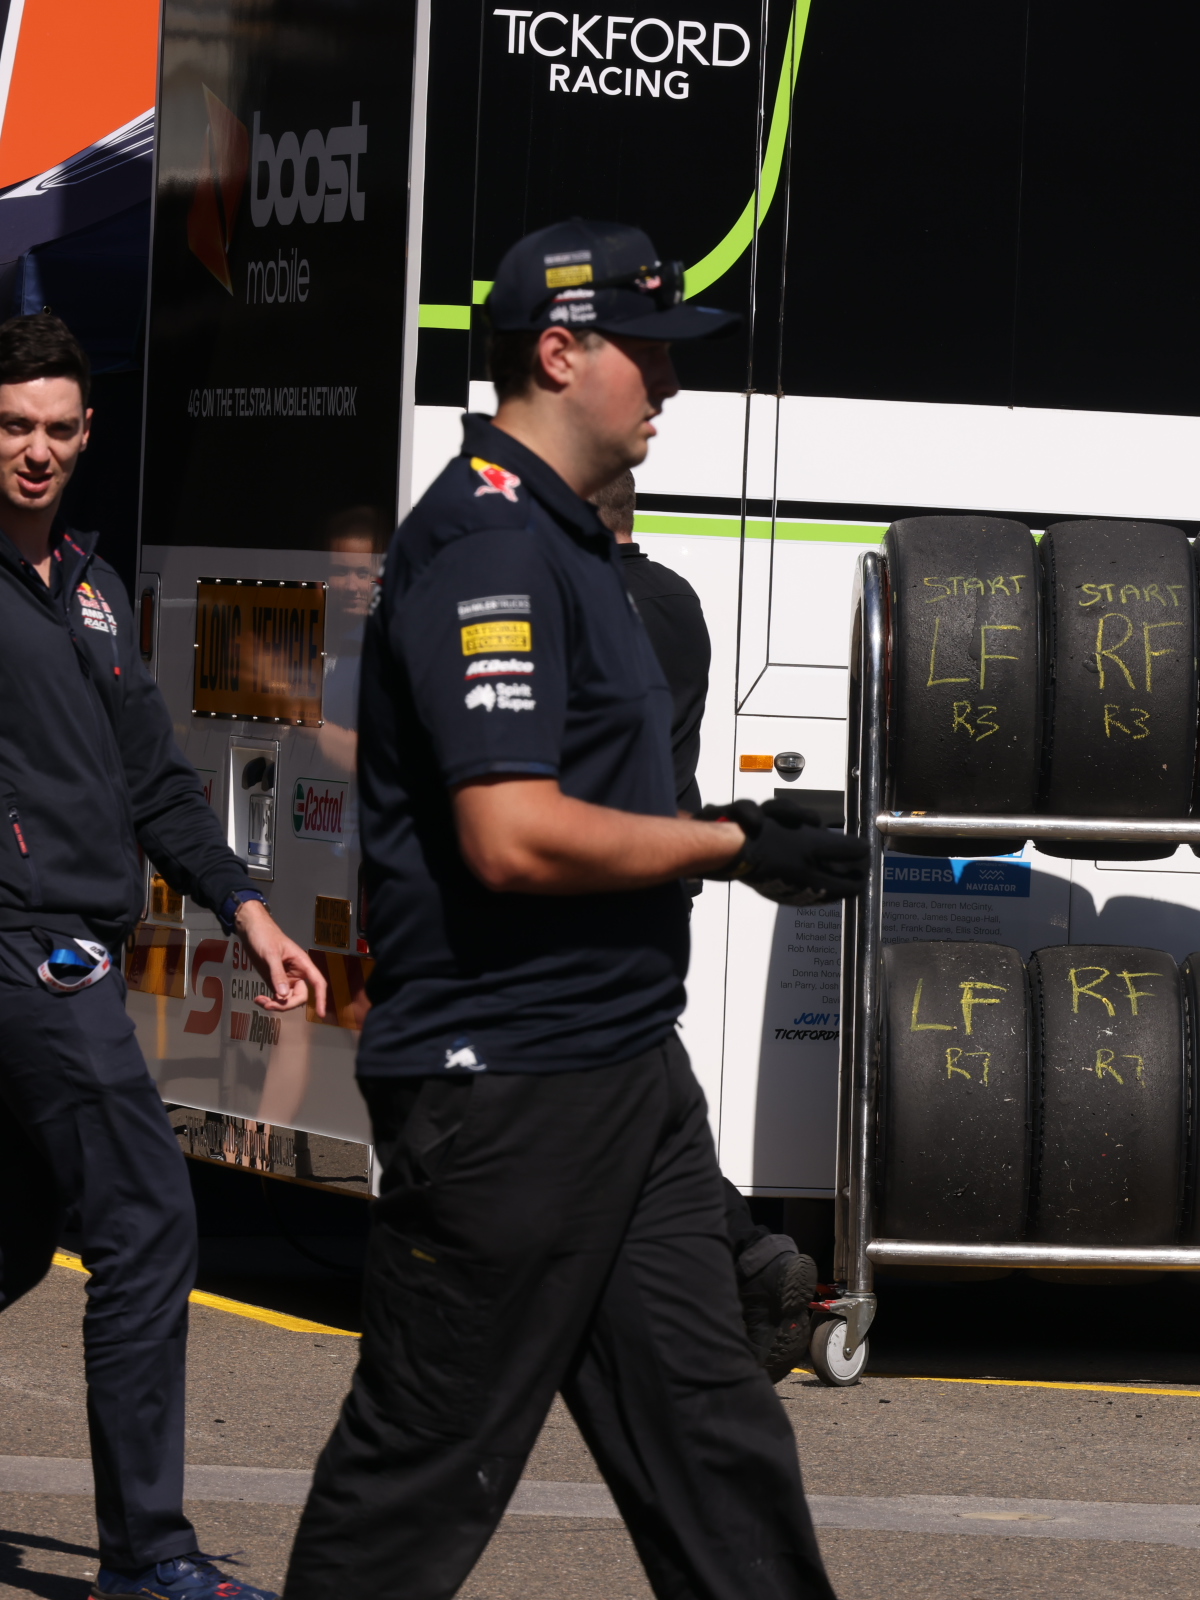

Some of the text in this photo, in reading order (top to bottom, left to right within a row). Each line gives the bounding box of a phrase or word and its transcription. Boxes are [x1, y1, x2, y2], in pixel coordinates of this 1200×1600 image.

[493, 9, 750, 67] TICKFORD
[549, 64, 690, 99] RACING
[249, 101, 368, 227] boost
[246, 247, 311, 304] mobile
[187, 386, 358, 418] 4G ON THE TELSTRA MOBILE NETWORK
[924, 575, 1028, 601] START
[1078, 583, 1186, 606] START
[200, 604, 319, 697] LONG VEHICLE
[926, 617, 1021, 691] LF
[1096, 613, 1185, 693] RF
[951, 701, 1000, 741] R3
[1103, 703, 1151, 739] R3
[304, 787, 343, 833] Castrol
[884, 867, 953, 883] EMBERS
[966, 882, 1017, 893] NAVIGATOR
[796, 908, 816, 917] Nikki
[902, 900, 928, 910] Barca,
[930, 901, 957, 910] Darren
[959, 902, 994, 913] McGinty,
[921, 913, 948, 922] James
[794, 920, 816, 929] Brian
[795, 933, 827, 941] Michael
[900, 923, 924, 933] Frank
[925, 925, 953, 936] Deane,
[955, 925, 972, 935] Ellis
[973, 926, 1003, 937] Stroud,
[787, 944, 838, 955] Rob Maricic,
[813, 957, 835, 968] Ryan
[780, 981, 840, 991] Ian Parry, Josh
[792, 969, 819, 978] Donna
[822, 995, 841, 1003] Davi
[1069, 966, 1165, 1017] RF
[794, 1012, 831, 1025] JOIN
[910, 978, 1008, 1036] LF
[249, 1010, 281, 1051] Repco
[947, 1046, 990, 1087] R7
[1096, 1047, 1147, 1088] R7
